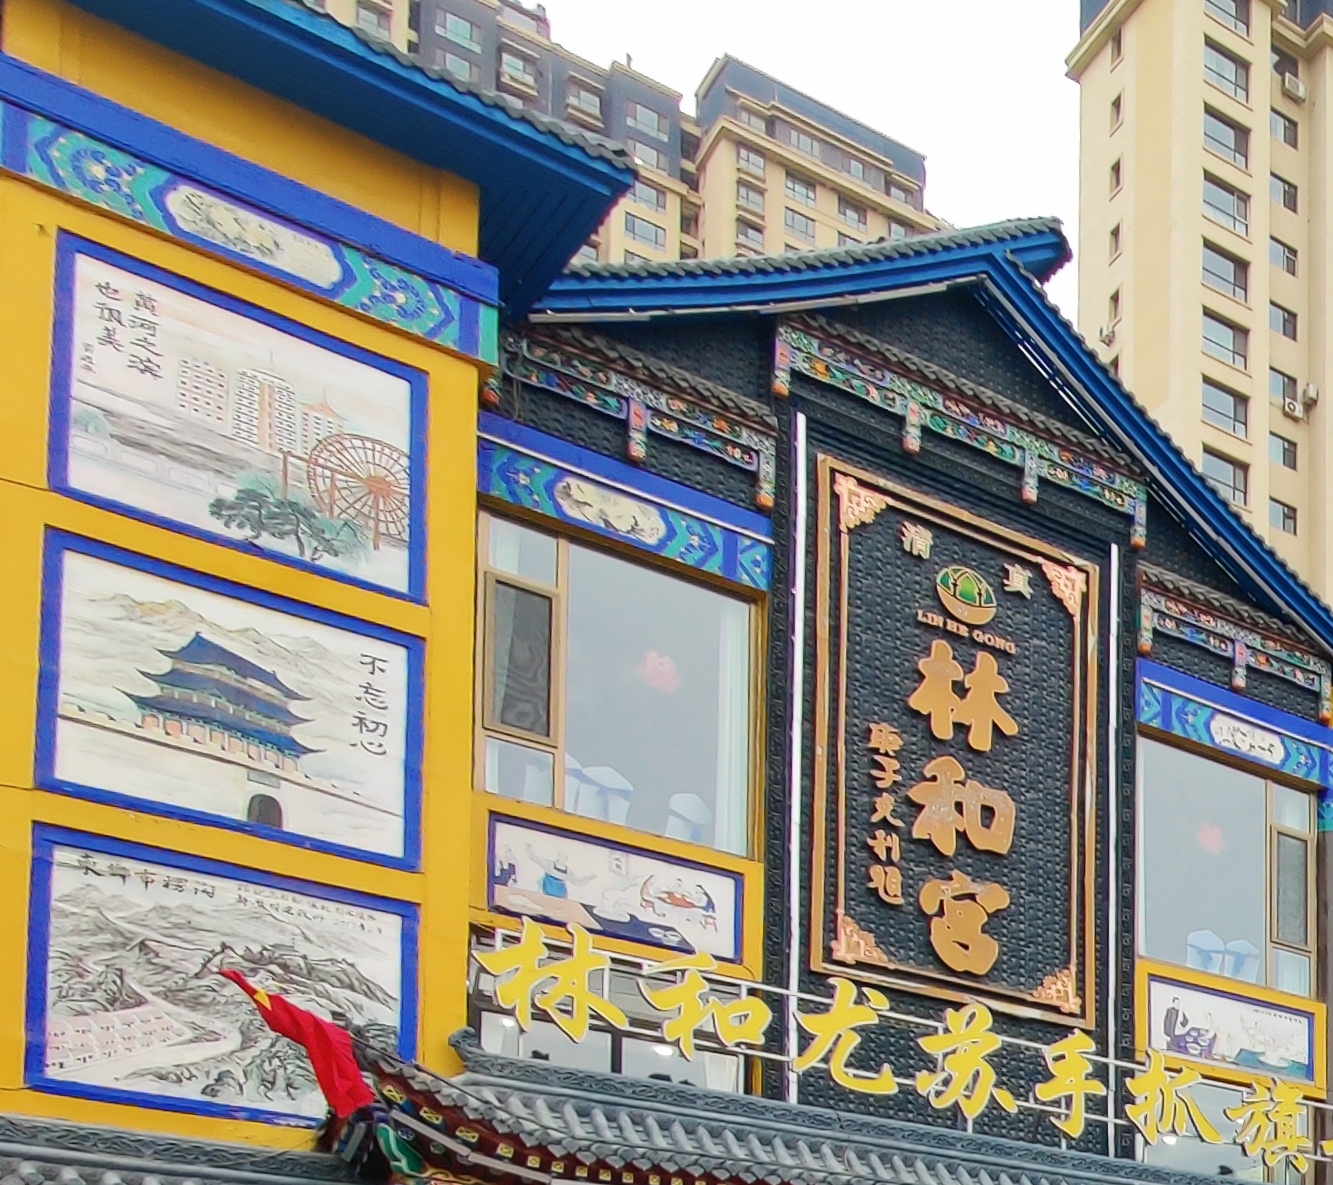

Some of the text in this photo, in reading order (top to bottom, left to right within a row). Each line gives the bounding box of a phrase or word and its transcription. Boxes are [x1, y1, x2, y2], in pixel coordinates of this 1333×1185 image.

[916, 609, 1016, 654] LIN HE GONG
[348, 652, 389, 758] 不忘初心
[908, 639, 1018, 976] 林和宫
